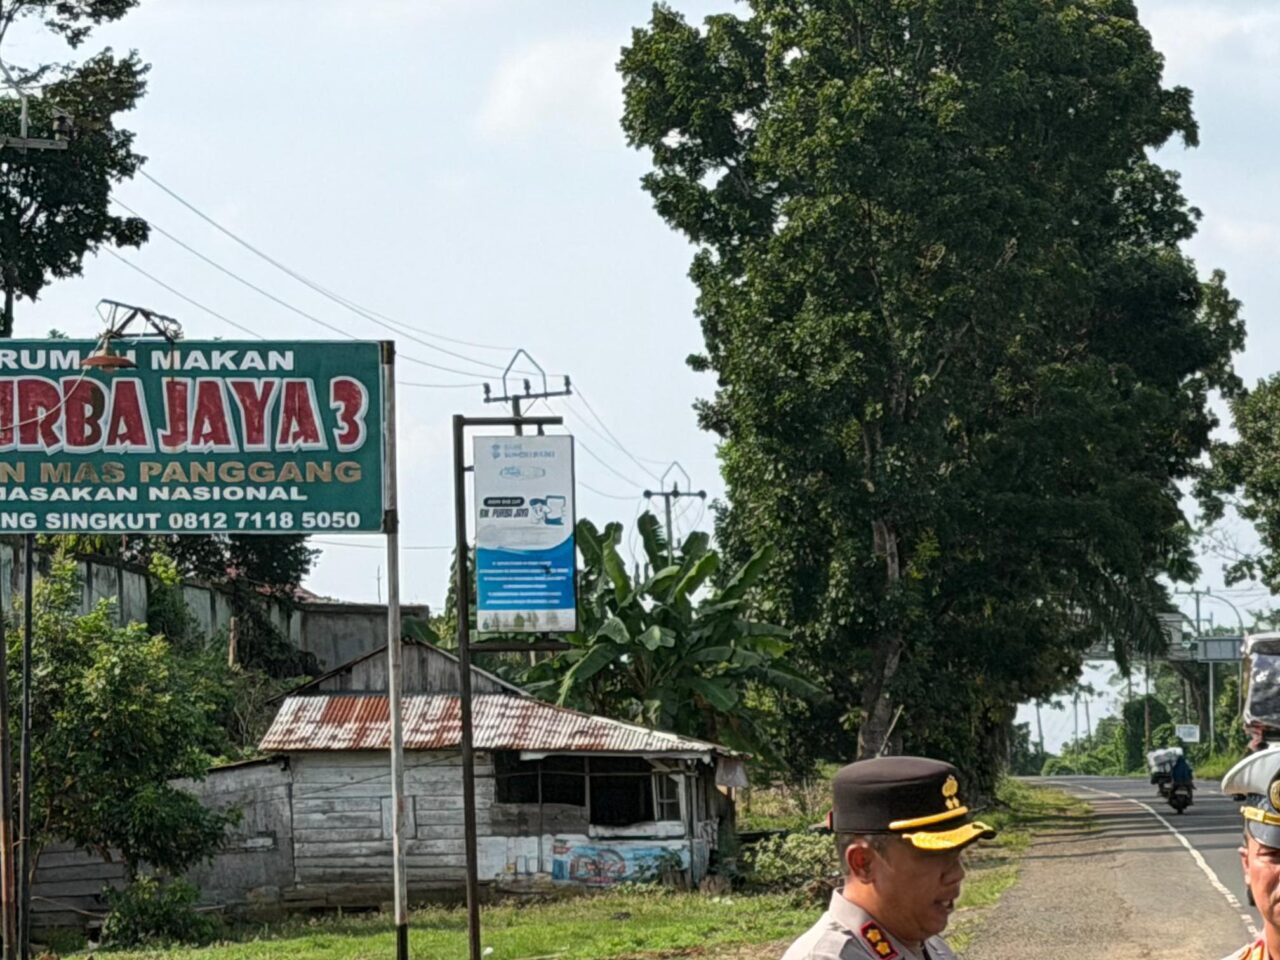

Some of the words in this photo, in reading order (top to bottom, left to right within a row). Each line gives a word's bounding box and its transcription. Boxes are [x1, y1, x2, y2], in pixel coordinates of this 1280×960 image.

[152, 350, 294, 370] MAKAN
[157, 376, 328, 455] JAYA
[330, 376, 369, 452] 3
[40, 461, 125, 483] MAS
[140, 461, 362, 483] PANGGANG
[0, 486, 138, 501] ASAKAN
[150, 486, 308, 501] NASIONAL
[46, 512, 160, 529] SINGKUT
[168, 512, 228, 529] 0812
[235, 511, 294, 528] 7118
[302, 511, 360, 528] 5050
